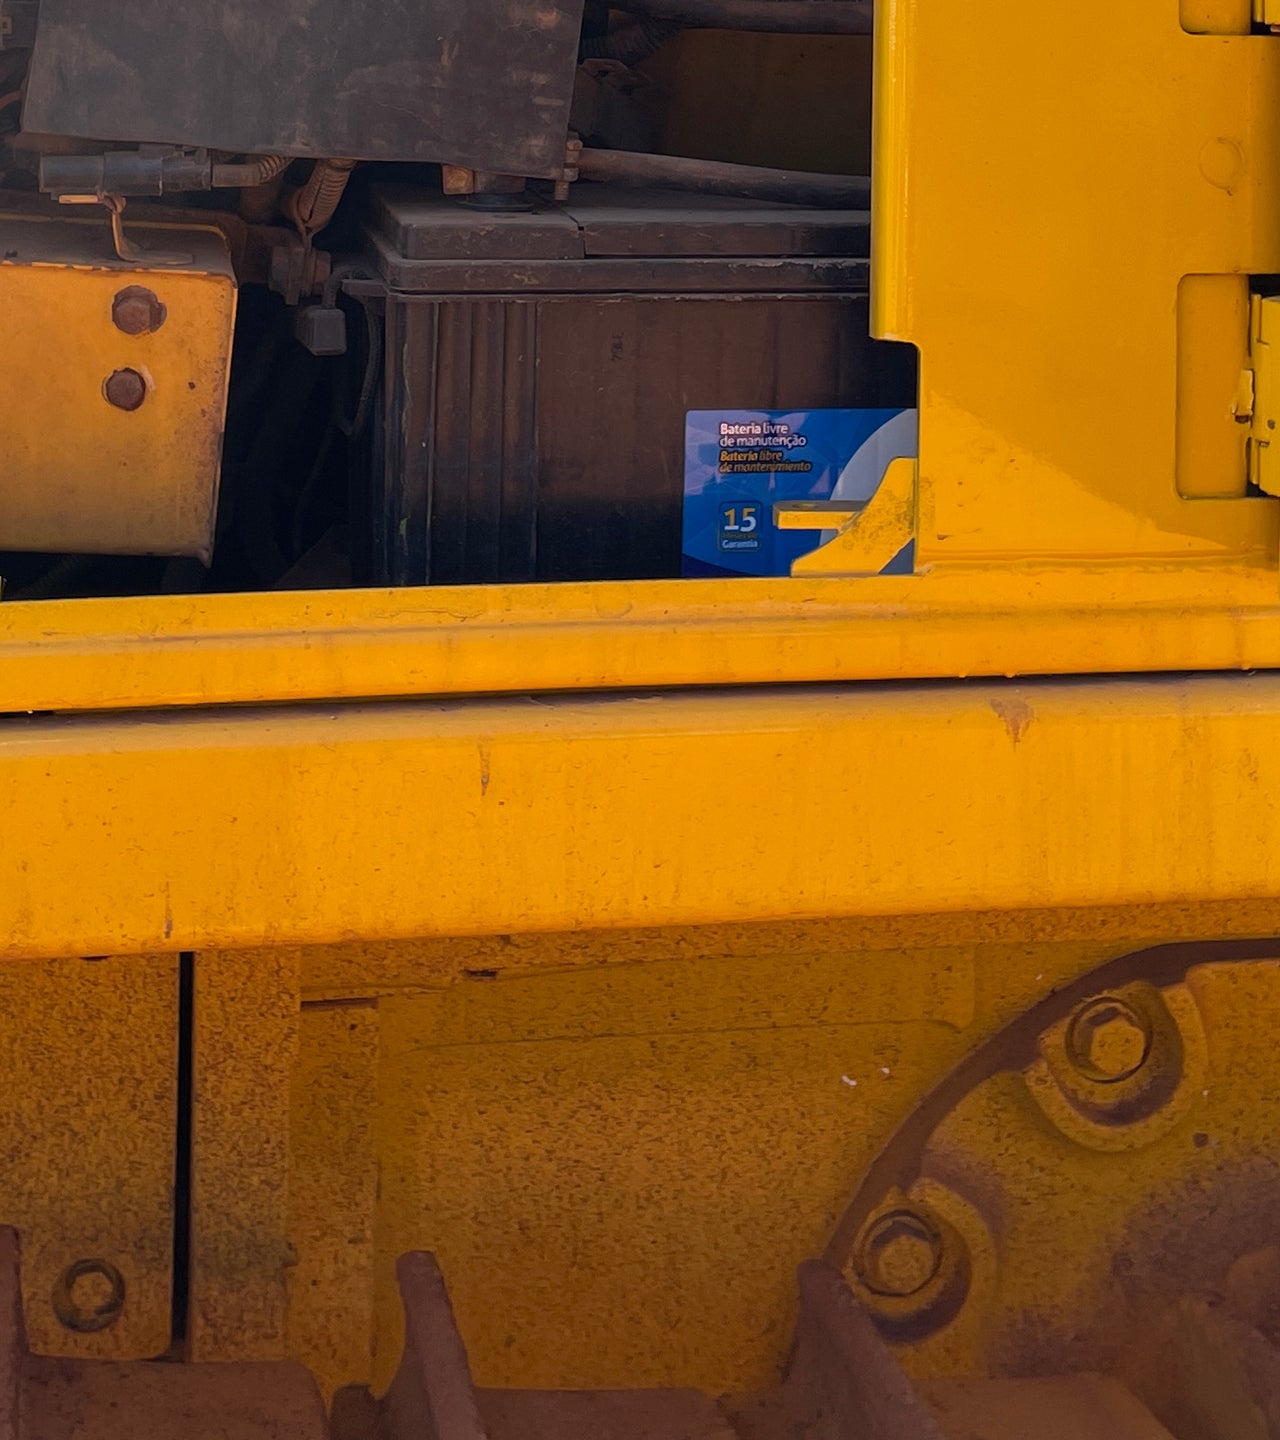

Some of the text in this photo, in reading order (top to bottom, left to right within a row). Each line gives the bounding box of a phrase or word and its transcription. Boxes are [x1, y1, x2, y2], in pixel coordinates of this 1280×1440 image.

[720, 422, 789, 435] Bateria livre
[720, 434, 807, 449] de manutenção
[760, 450, 783, 461] libre
[720, 462, 733, 472] de
[723, 507, 757, 532] 15
